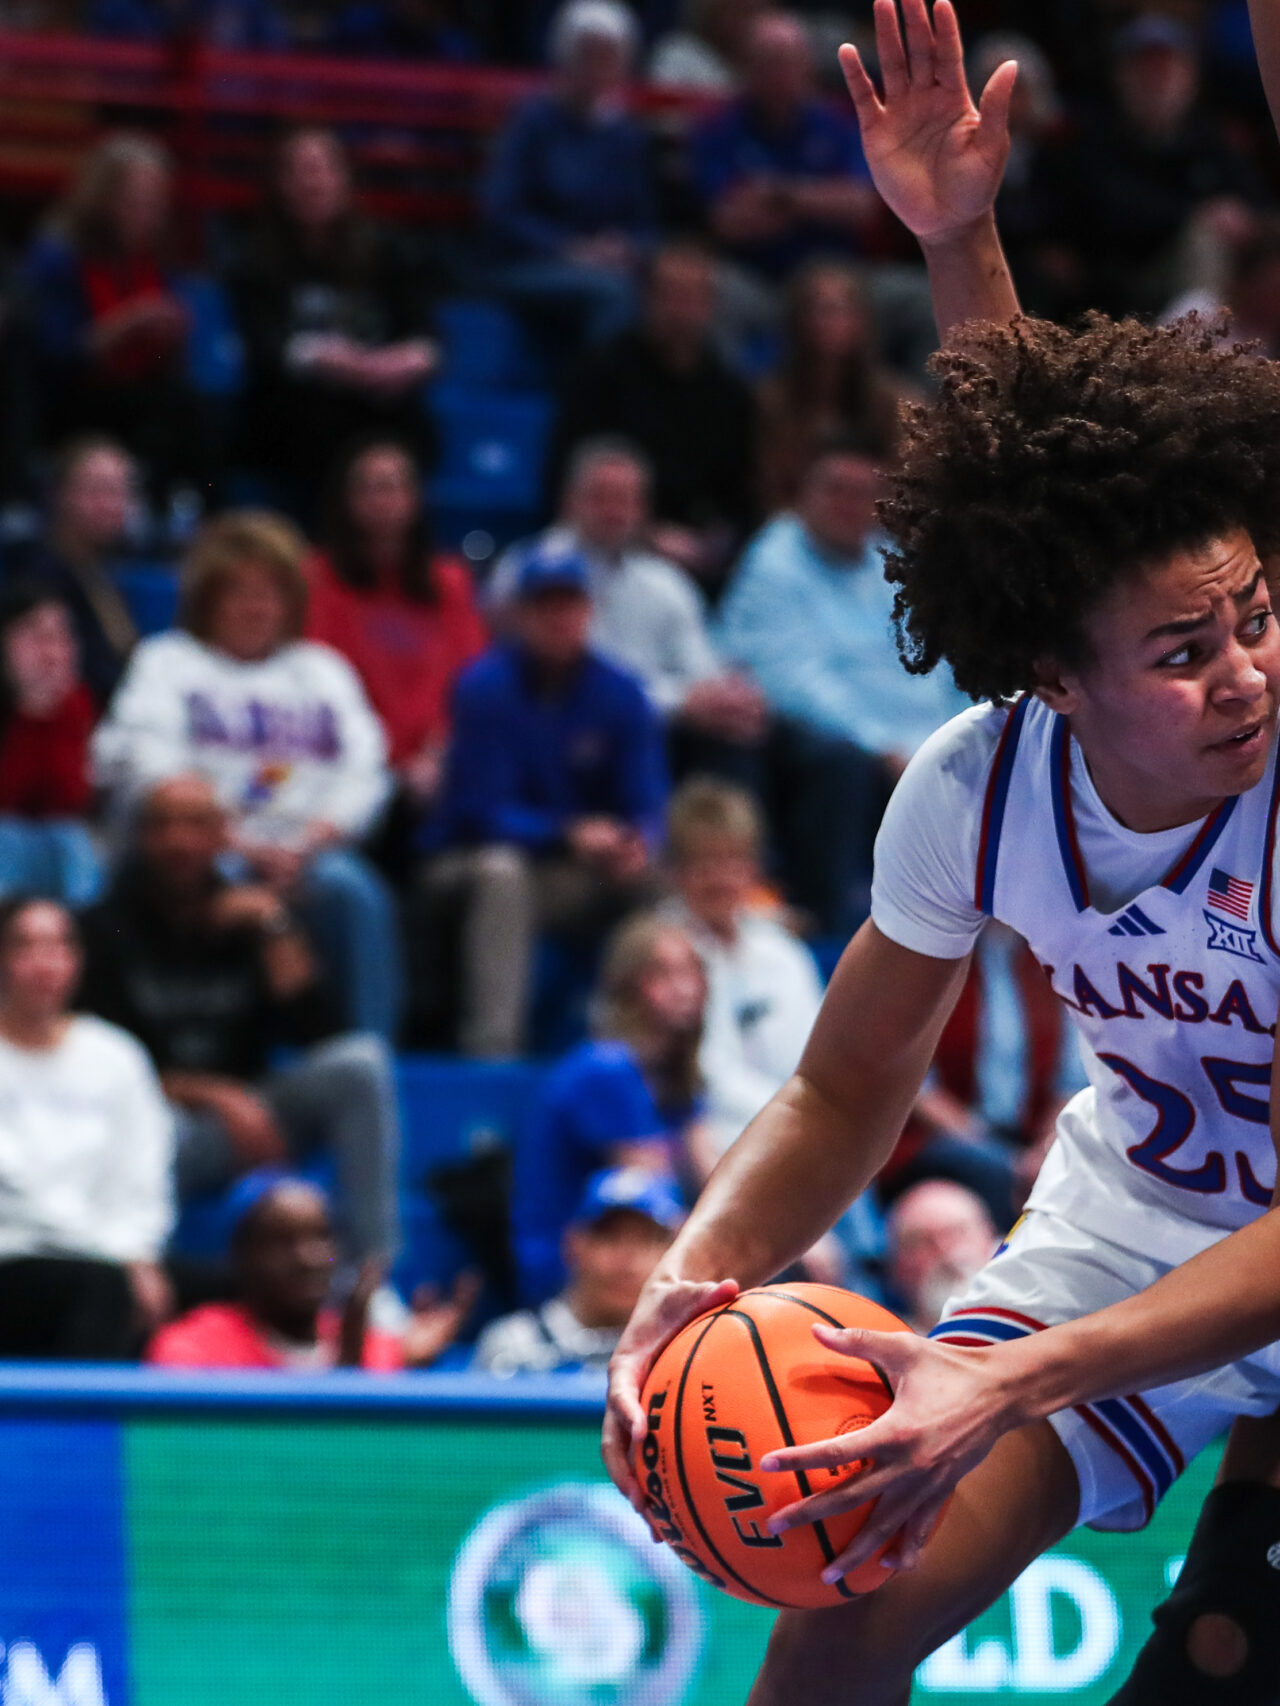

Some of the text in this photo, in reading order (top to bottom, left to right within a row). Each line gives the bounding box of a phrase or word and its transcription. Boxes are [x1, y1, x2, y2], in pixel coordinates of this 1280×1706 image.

[1043, 961, 1277, 1037] ANSA
[1095, 1052, 1275, 1207] 25
[701, 1381, 785, 1548] EVO NXT
